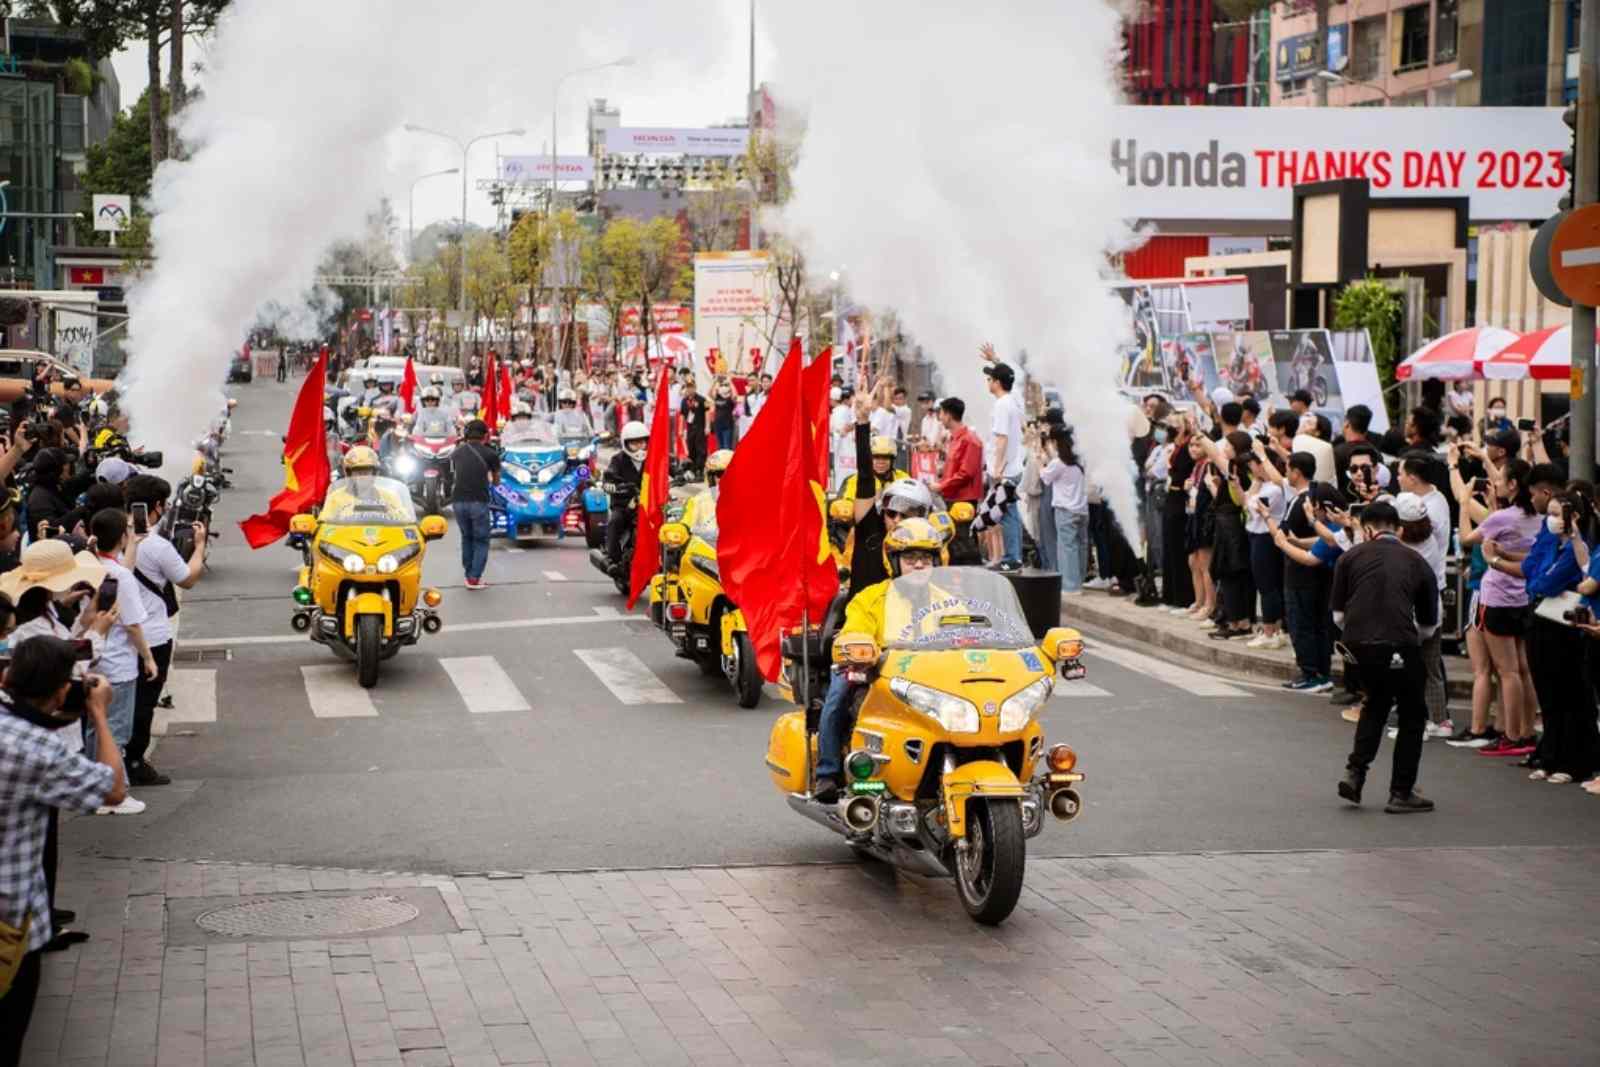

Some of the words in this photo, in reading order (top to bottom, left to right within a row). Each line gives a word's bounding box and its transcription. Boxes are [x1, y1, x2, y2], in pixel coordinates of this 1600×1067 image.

[1110, 139, 1246, 187] Honda
[1254, 150, 1392, 188] THANKS
[1403, 151, 1466, 188] DAY
[1476, 151, 1566, 188] 2023
